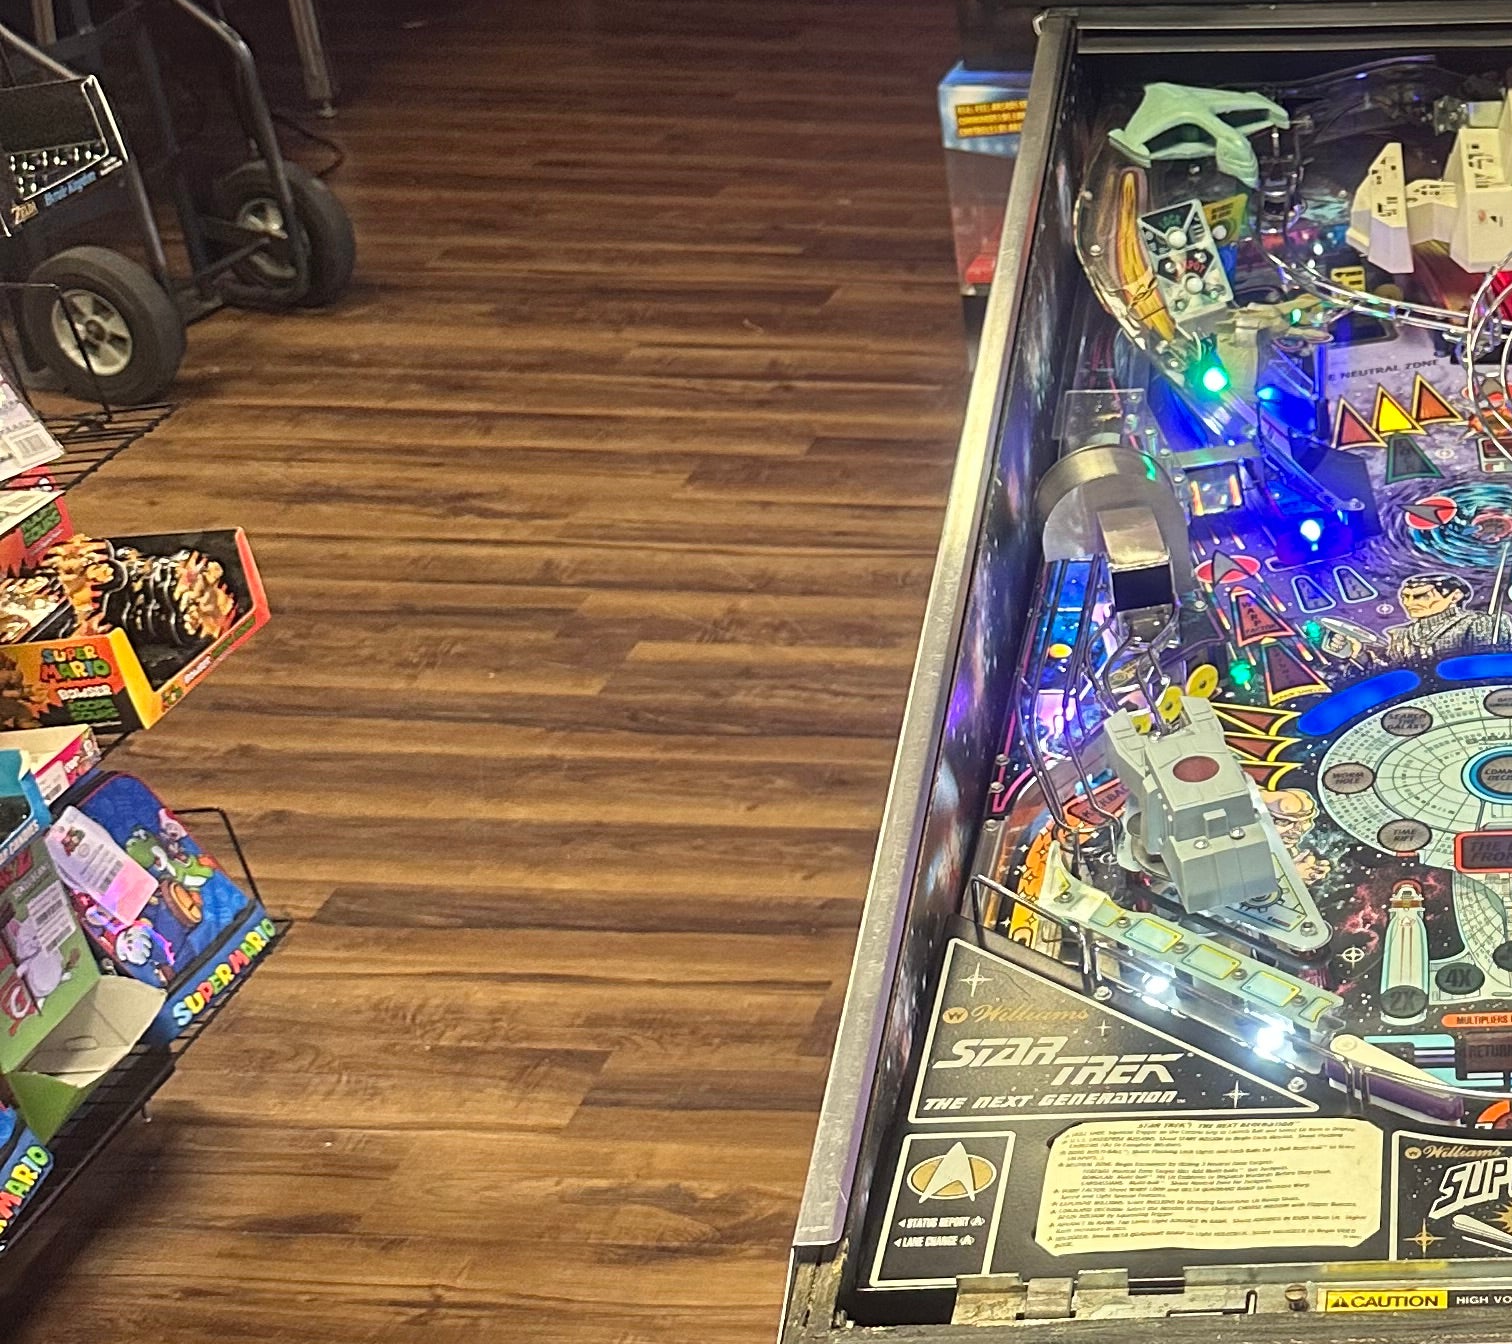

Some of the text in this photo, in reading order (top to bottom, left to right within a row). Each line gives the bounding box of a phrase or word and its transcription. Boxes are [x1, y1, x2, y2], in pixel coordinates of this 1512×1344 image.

[1341, 359, 1440, 379] NEUTRAL ZONE
[41, 646, 98, 662] SUPER
[40, 659, 112, 682] MARIO
[172, 917, 277, 1027] SUPER MARIO
[1444, 968, 1472, 982] 4X
[970, 1005, 1089, 1023] Williams
[1456, 1016, 1508, 1024] MULTIPLIERS
[932, 1036, 1069, 1069] STAR
[1050, 1052, 1185, 1086] TREK
[923, 1090, 1178, 1111] THE NEXT GENERATION
[1422, 1145, 1502, 1159] Williams
[907, 1217, 971, 1228] STATUS REPORT
[1350, 1295, 1439, 1308] CAUTION
[1456, 1295, 1489, 1305] HIGH
